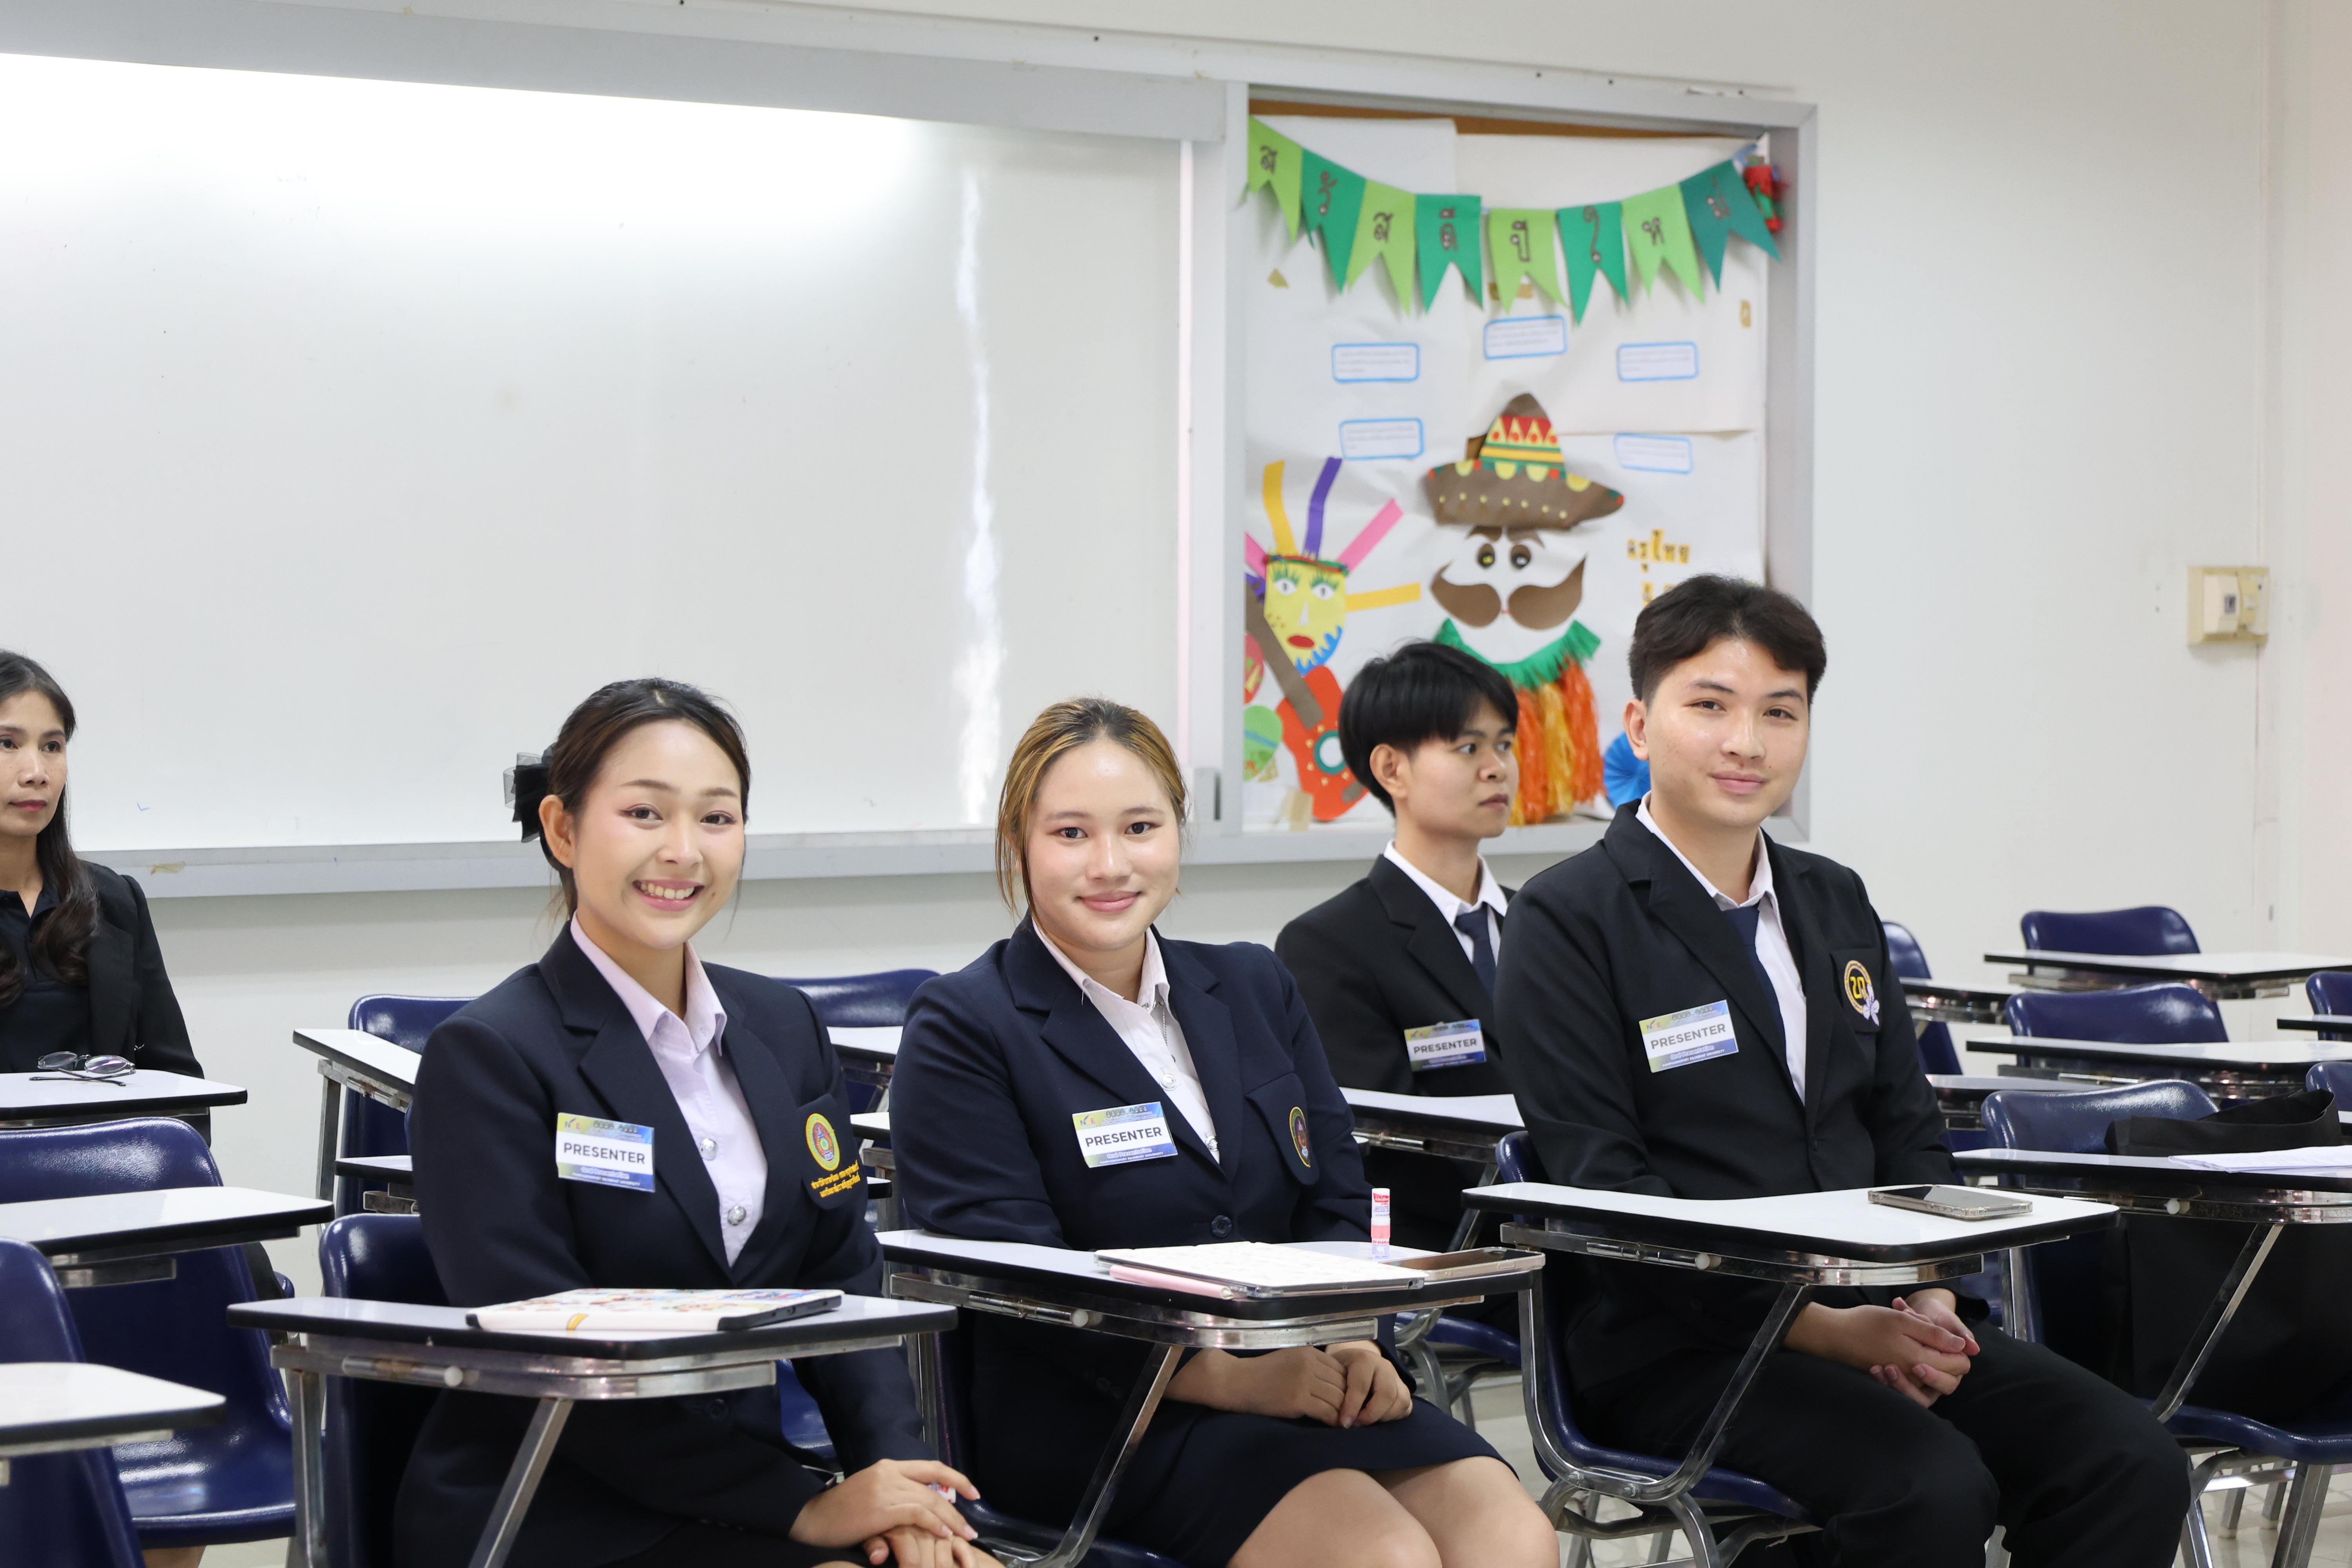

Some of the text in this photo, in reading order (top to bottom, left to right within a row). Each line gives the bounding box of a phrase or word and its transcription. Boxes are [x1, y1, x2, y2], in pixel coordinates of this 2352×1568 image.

[1413, 1038, 1477, 1054] PRESENTER
[1650, 1023, 1726, 1049] PRESENTER
[1085, 1127, 1162, 1147] PRESENTER
[564, 1142, 645, 1164] PRESENTER
[1119, 1148, 1152, 1157] Presentation
